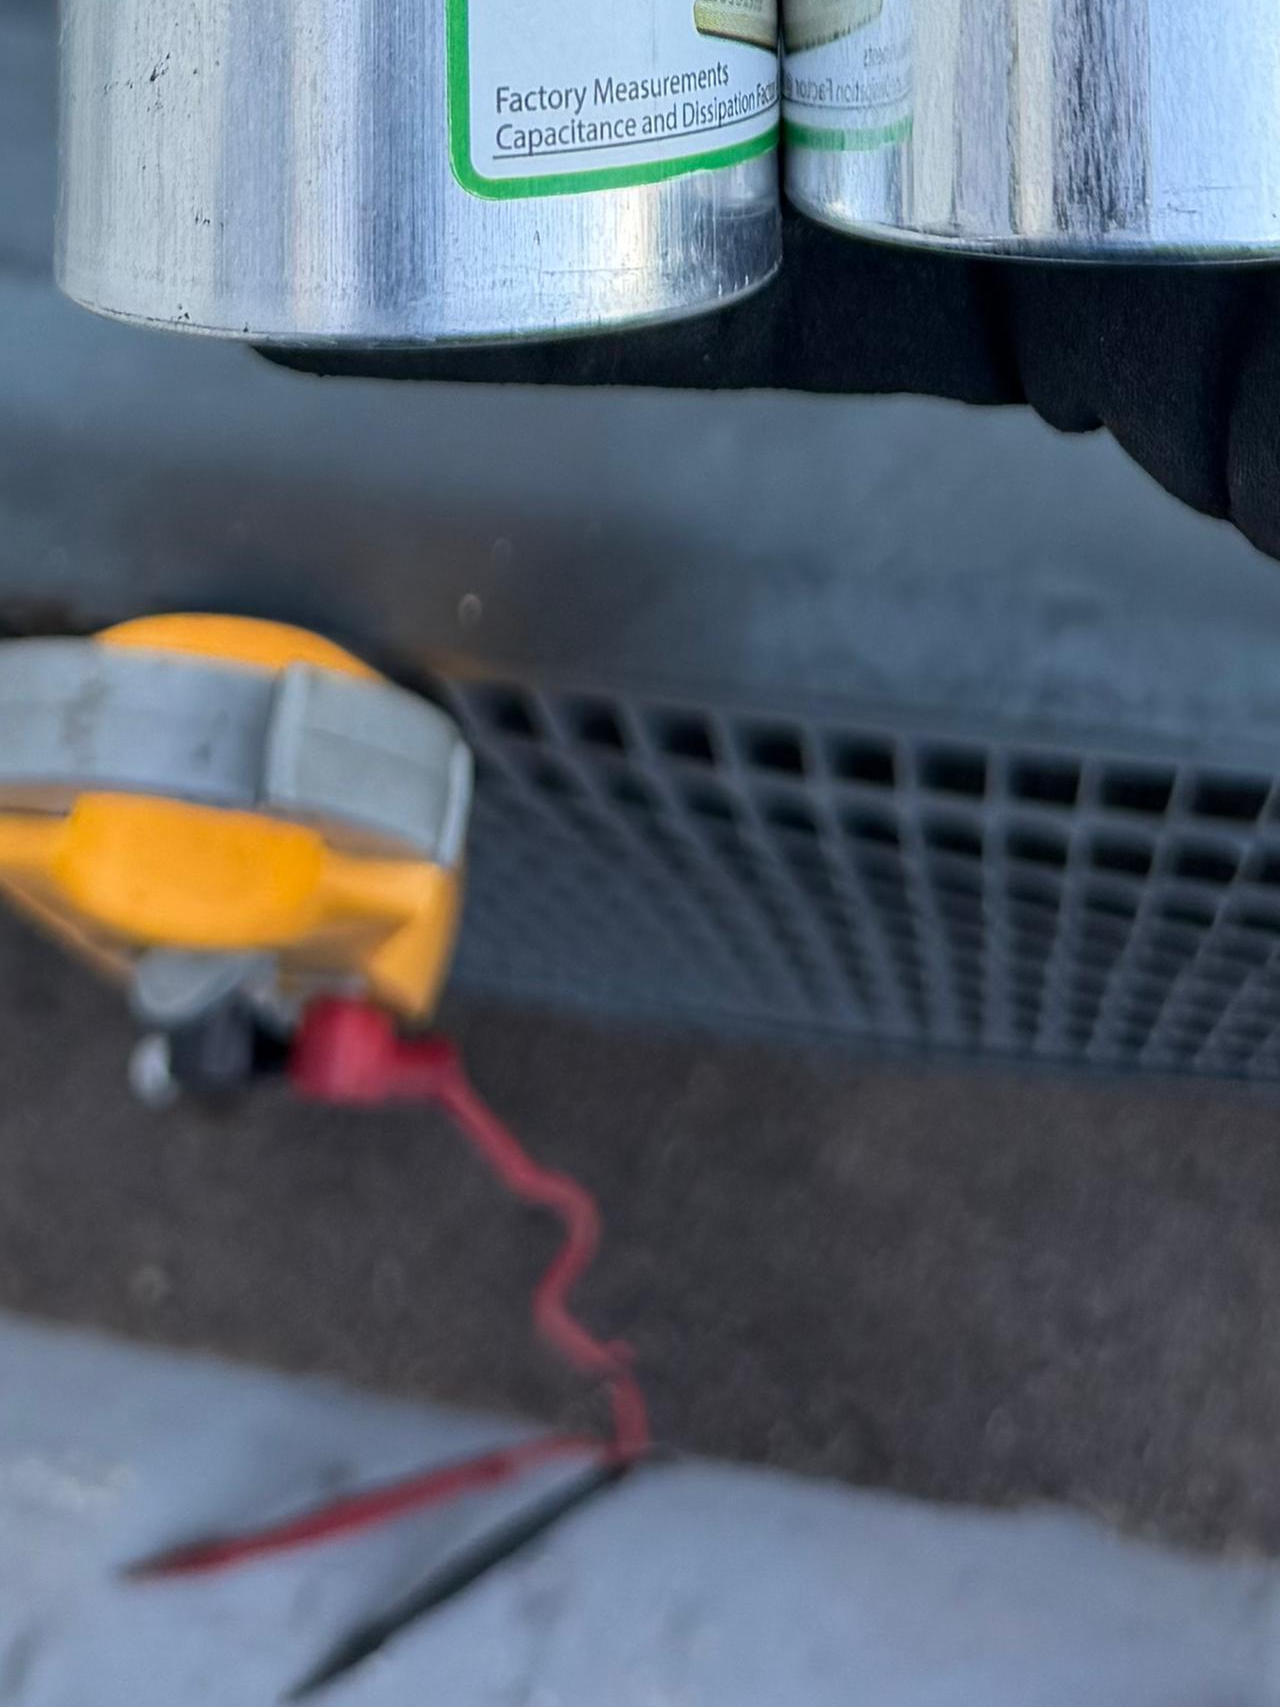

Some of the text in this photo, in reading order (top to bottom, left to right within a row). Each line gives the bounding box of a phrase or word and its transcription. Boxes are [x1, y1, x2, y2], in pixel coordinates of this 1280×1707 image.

[496, 60, 728, 117] Factory Measurements
[496, 114, 637, 156] Capacitance
[641, 106, 678, 134] and
[682, 89, 755, 128] Dissipation
